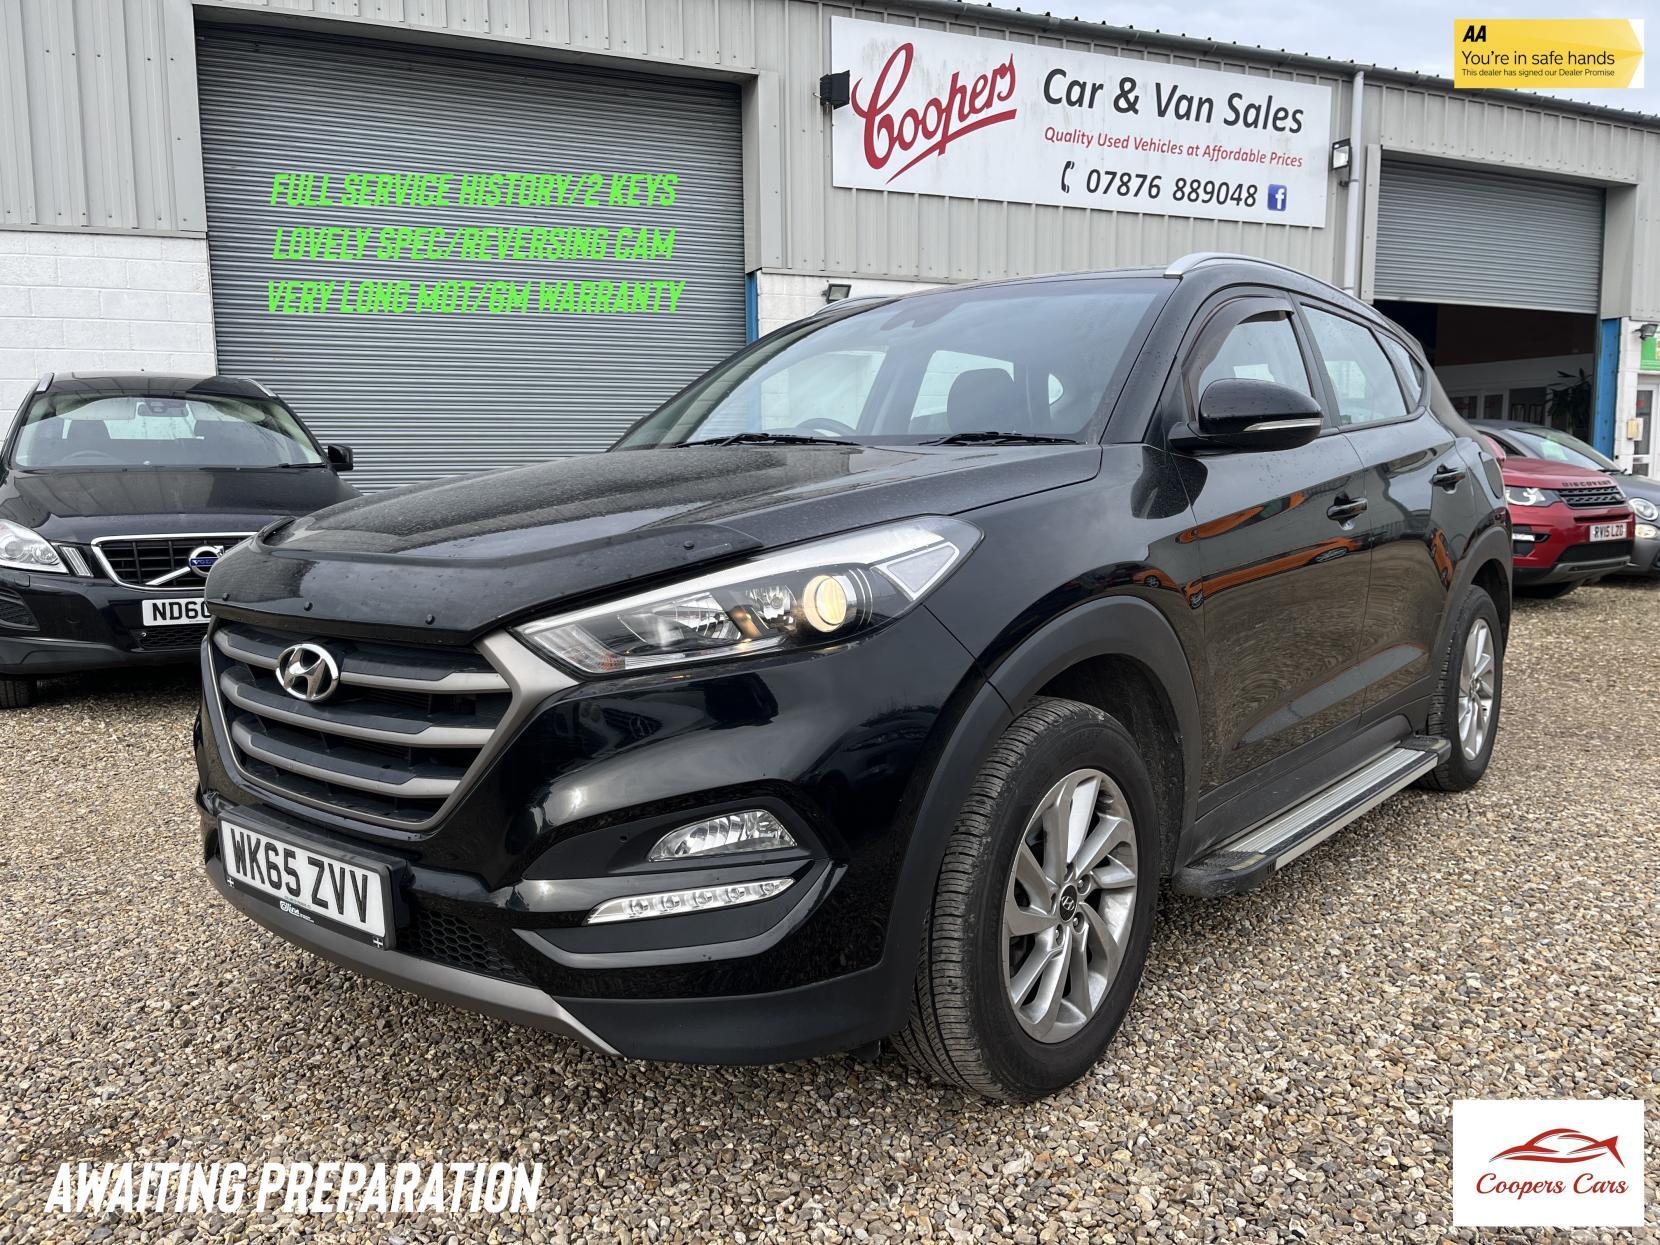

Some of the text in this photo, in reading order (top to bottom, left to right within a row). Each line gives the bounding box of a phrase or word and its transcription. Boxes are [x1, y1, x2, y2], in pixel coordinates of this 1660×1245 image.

[851, 42, 1016, 170] Coopers
[1043, 68, 1305, 134] Car & Van Sales
[1044, 126, 1304, 168] Quality Used Vehicles at Affordable Prices
[1085, 168, 1258, 207] 07876 889048
[230, 827, 368, 924] WK65 ZVV
